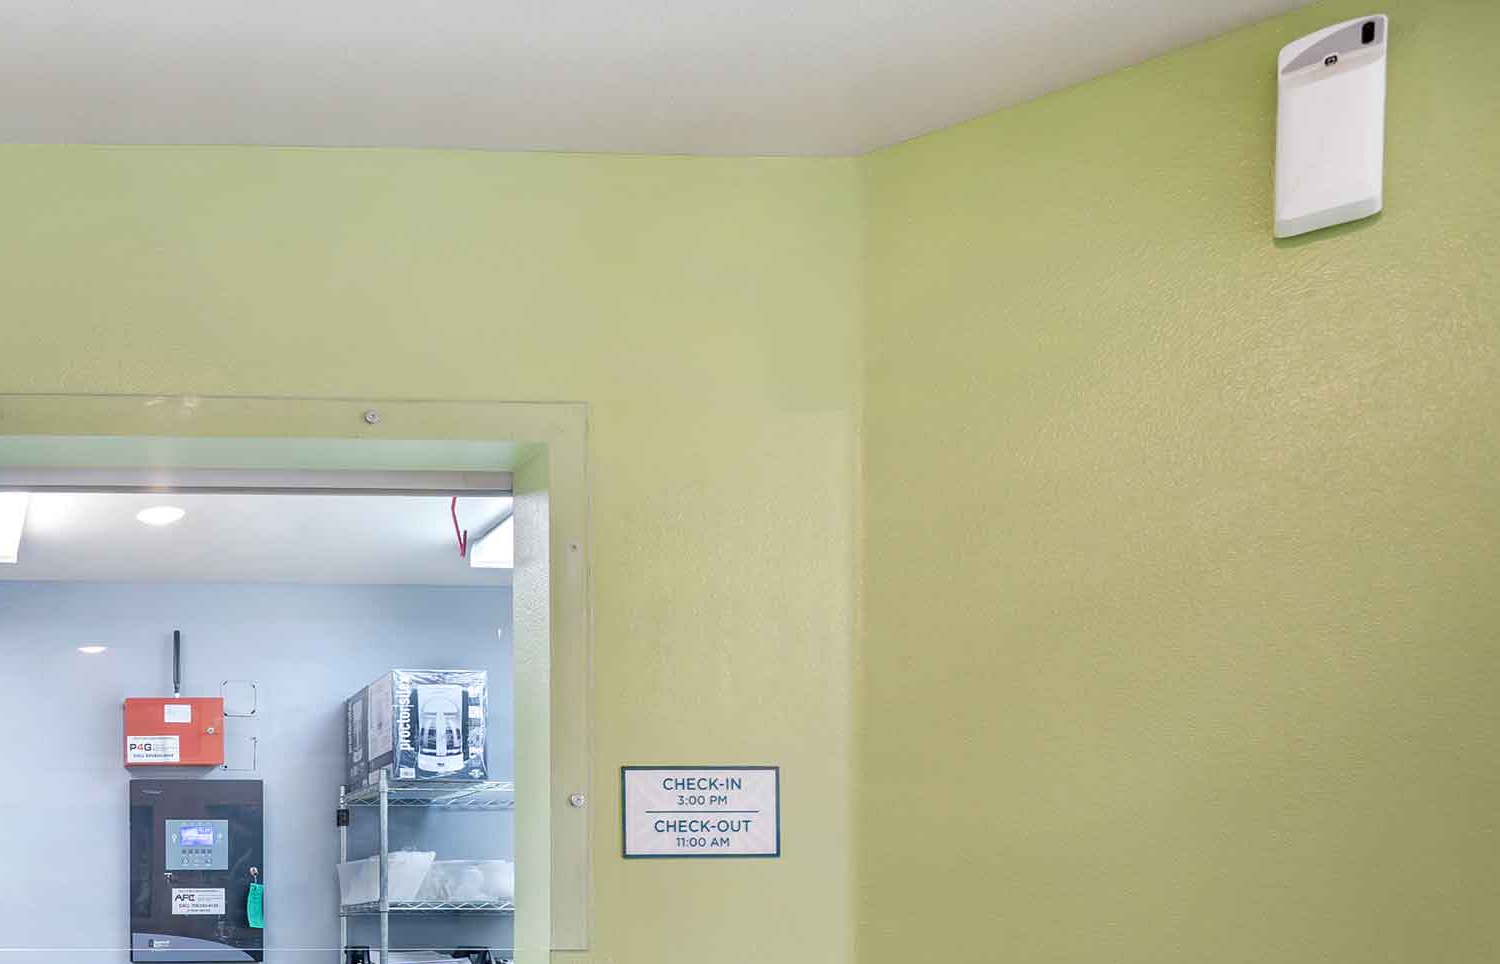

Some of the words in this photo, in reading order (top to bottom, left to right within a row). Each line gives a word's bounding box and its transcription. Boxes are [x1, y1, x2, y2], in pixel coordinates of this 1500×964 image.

[129, 743, 152, 752] P4G
[663, 778, 741, 790] CHECK-IN
[678, 796, 705, 805] 3:00
[710, 796, 727, 805] PM
[655, 820, 751, 832] CHECK-OUT
[676, 837, 706, 847] 11:00
[711, 838, 729, 847] AM
[174, 894, 195, 902] AFC
